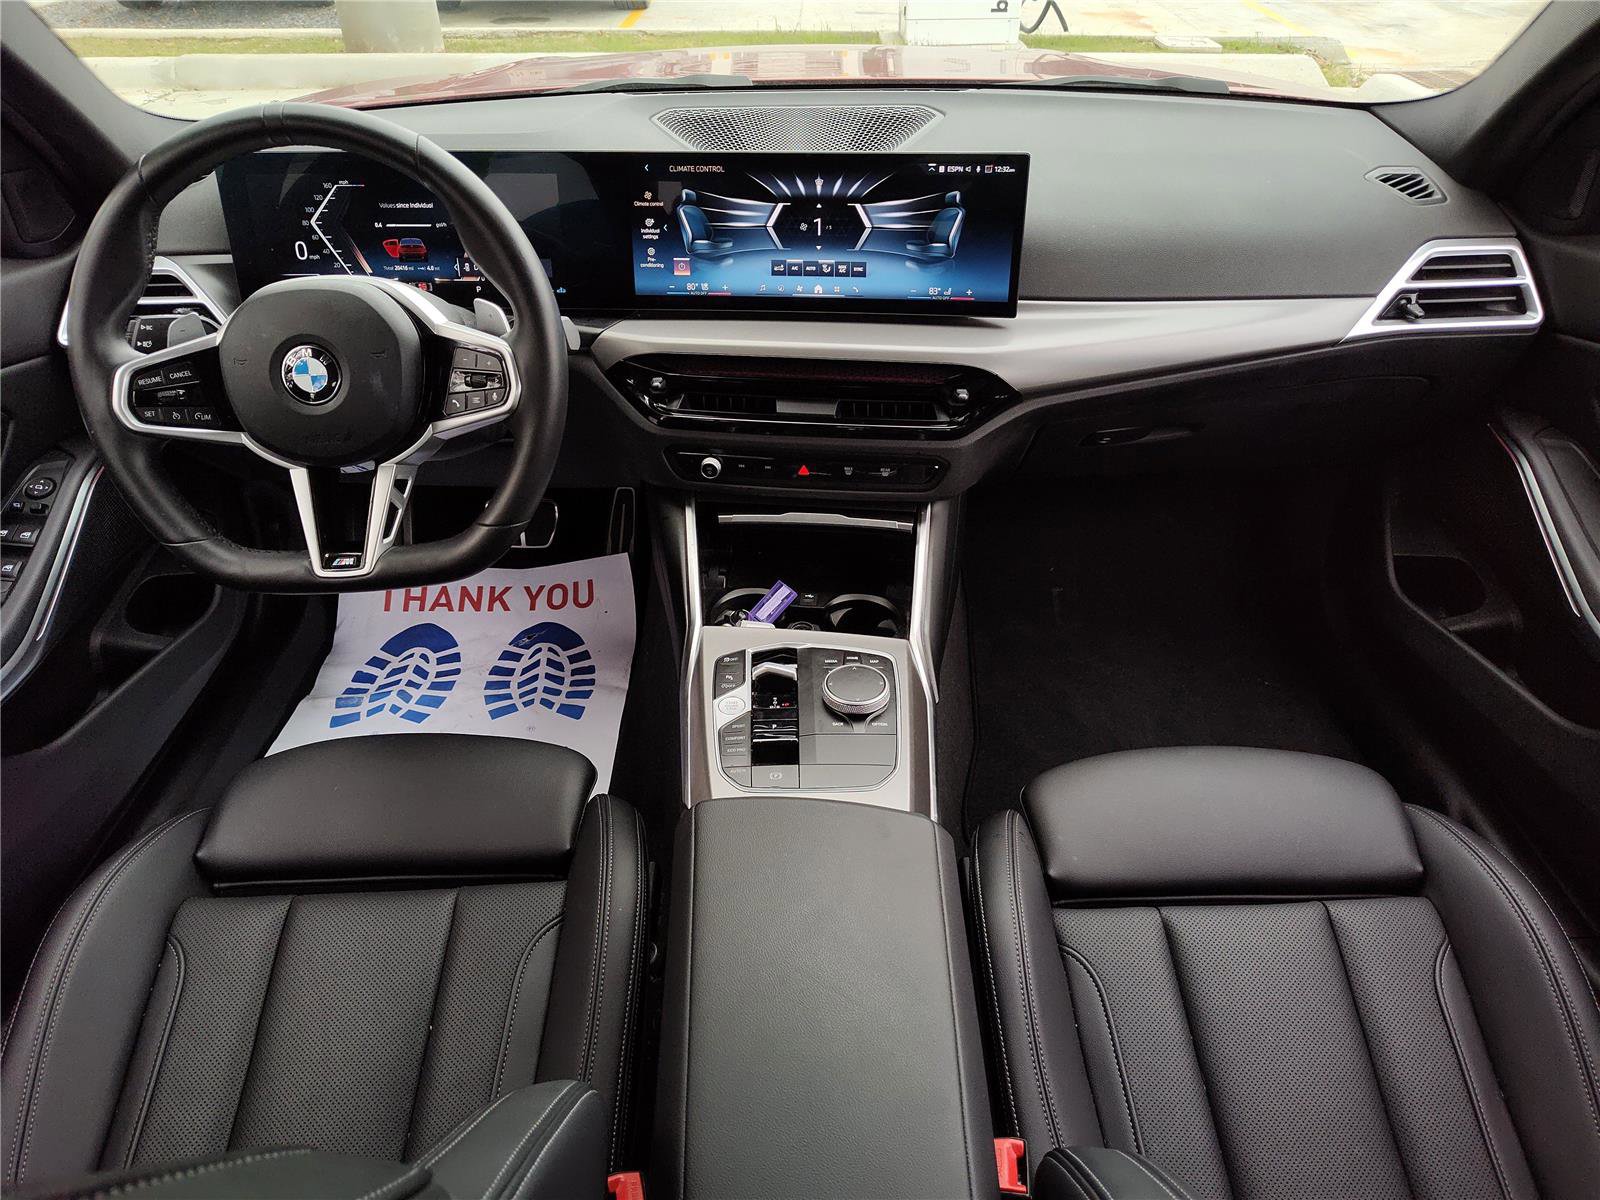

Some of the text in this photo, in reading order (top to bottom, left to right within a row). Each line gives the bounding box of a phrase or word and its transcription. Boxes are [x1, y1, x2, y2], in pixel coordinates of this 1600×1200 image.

[947, 165, 963, 173] ESPN
[813, 217, 821, 236] 1
[294, 241, 308, 260] 0
[138, 375, 162, 386] RESUME
[169, 370, 192, 380] CANCEL
[523, 579, 595, 611] YOU
